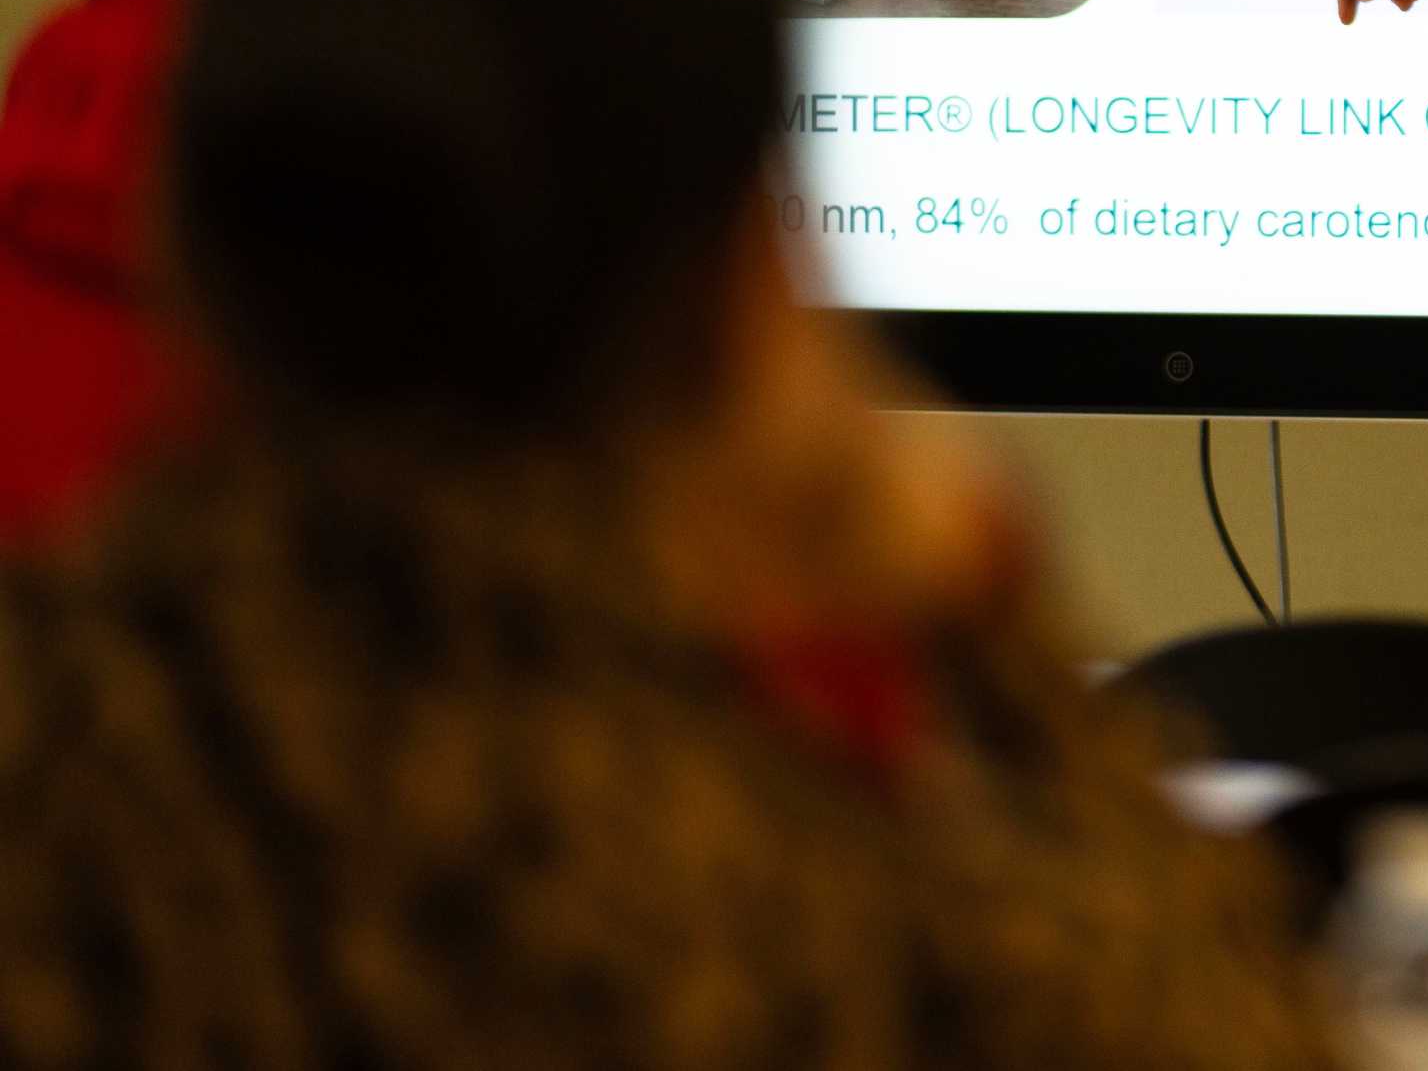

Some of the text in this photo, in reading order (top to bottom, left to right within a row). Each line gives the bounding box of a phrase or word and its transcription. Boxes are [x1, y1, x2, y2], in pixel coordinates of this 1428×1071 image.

[988, 96, 1282, 142] (LONGEVITY
[1300, 97, 1407, 135] LINK
[822, 204, 898, 241] nm,
[915, 195, 1009, 236] 84%
[1039, 197, 1081, 237] of
[1094, 198, 1240, 247] dietary
